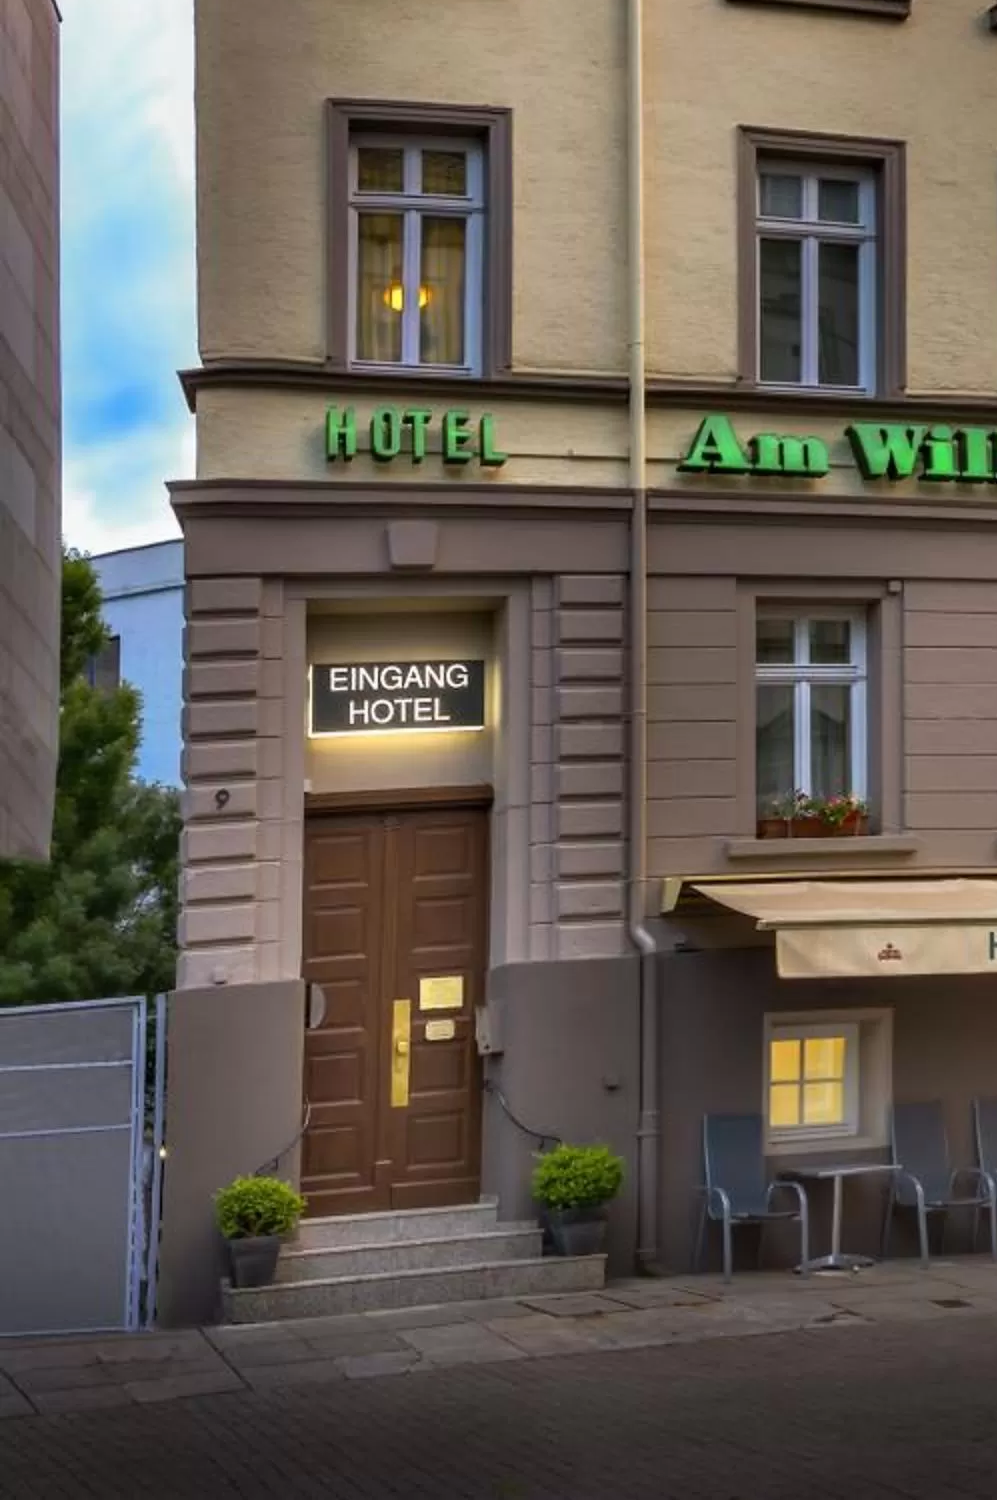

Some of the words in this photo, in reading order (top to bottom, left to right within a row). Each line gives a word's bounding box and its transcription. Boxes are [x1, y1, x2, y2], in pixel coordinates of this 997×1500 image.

[325, 402, 509, 466] HOTEL
[676, 412, 831, 478] Am
[329, 663, 470, 693] EINGANG
[349, 697, 451, 725] HOTEL
[215, 788, 230, 811] 9
